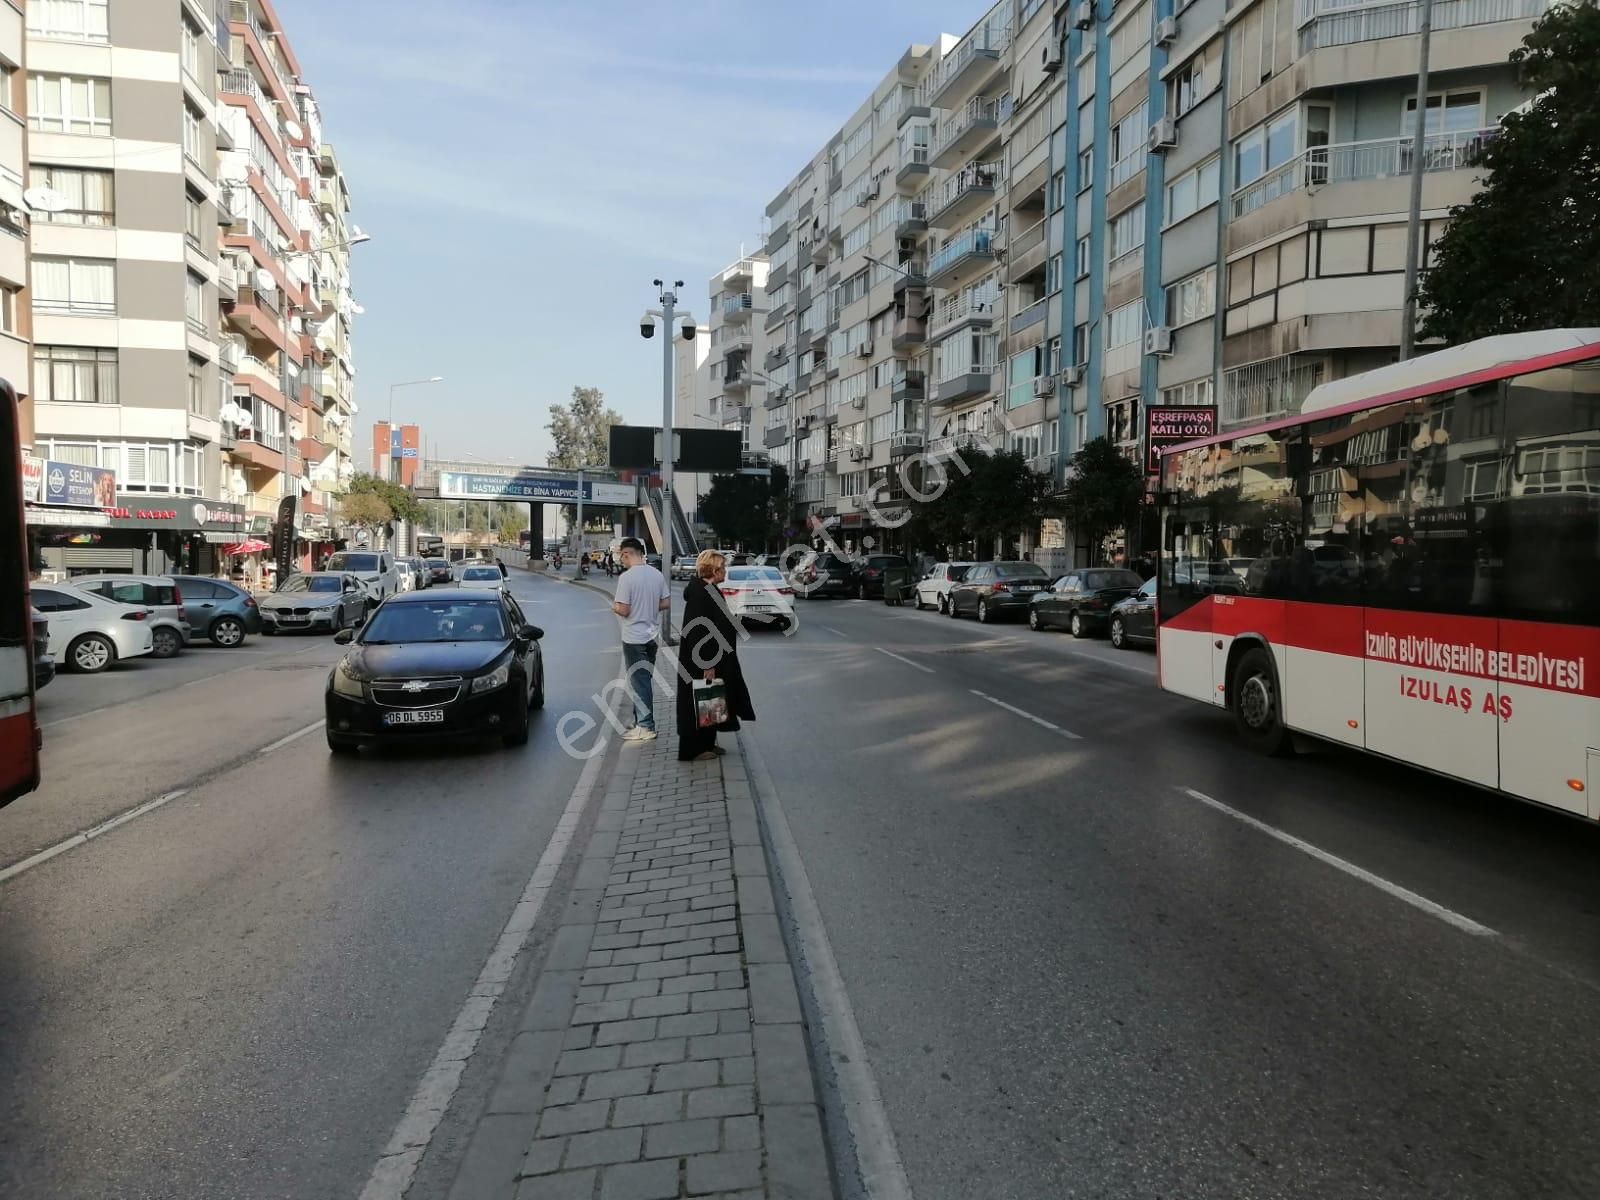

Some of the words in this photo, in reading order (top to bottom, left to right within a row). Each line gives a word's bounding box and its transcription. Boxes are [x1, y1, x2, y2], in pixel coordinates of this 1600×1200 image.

[1152, 412, 1212, 424] EŞREFPAŞA
[1151, 424, 1182, 434] KATLI
[1184, 424, 1211, 434] OTO.
[68, 467, 93, 484] SELİN
[472, 484, 522, 495] HASTANEMİZE
[523, 487, 533, 495] EK
[533, 486, 550, 496] BİNA
[551, 488, 588, 498] YAPIYORZ
[1365, 630, 1397, 660] İZMİR
[1399, 635, 1485, 675] BÜYÜKŞEHİR
[1487, 651, 1585, 691] BELEDİYESİ
[1482, 692, 1513, 724] AŞ
[388, 712, 401, 723] 06
[417, 711, 443, 722] 5955
